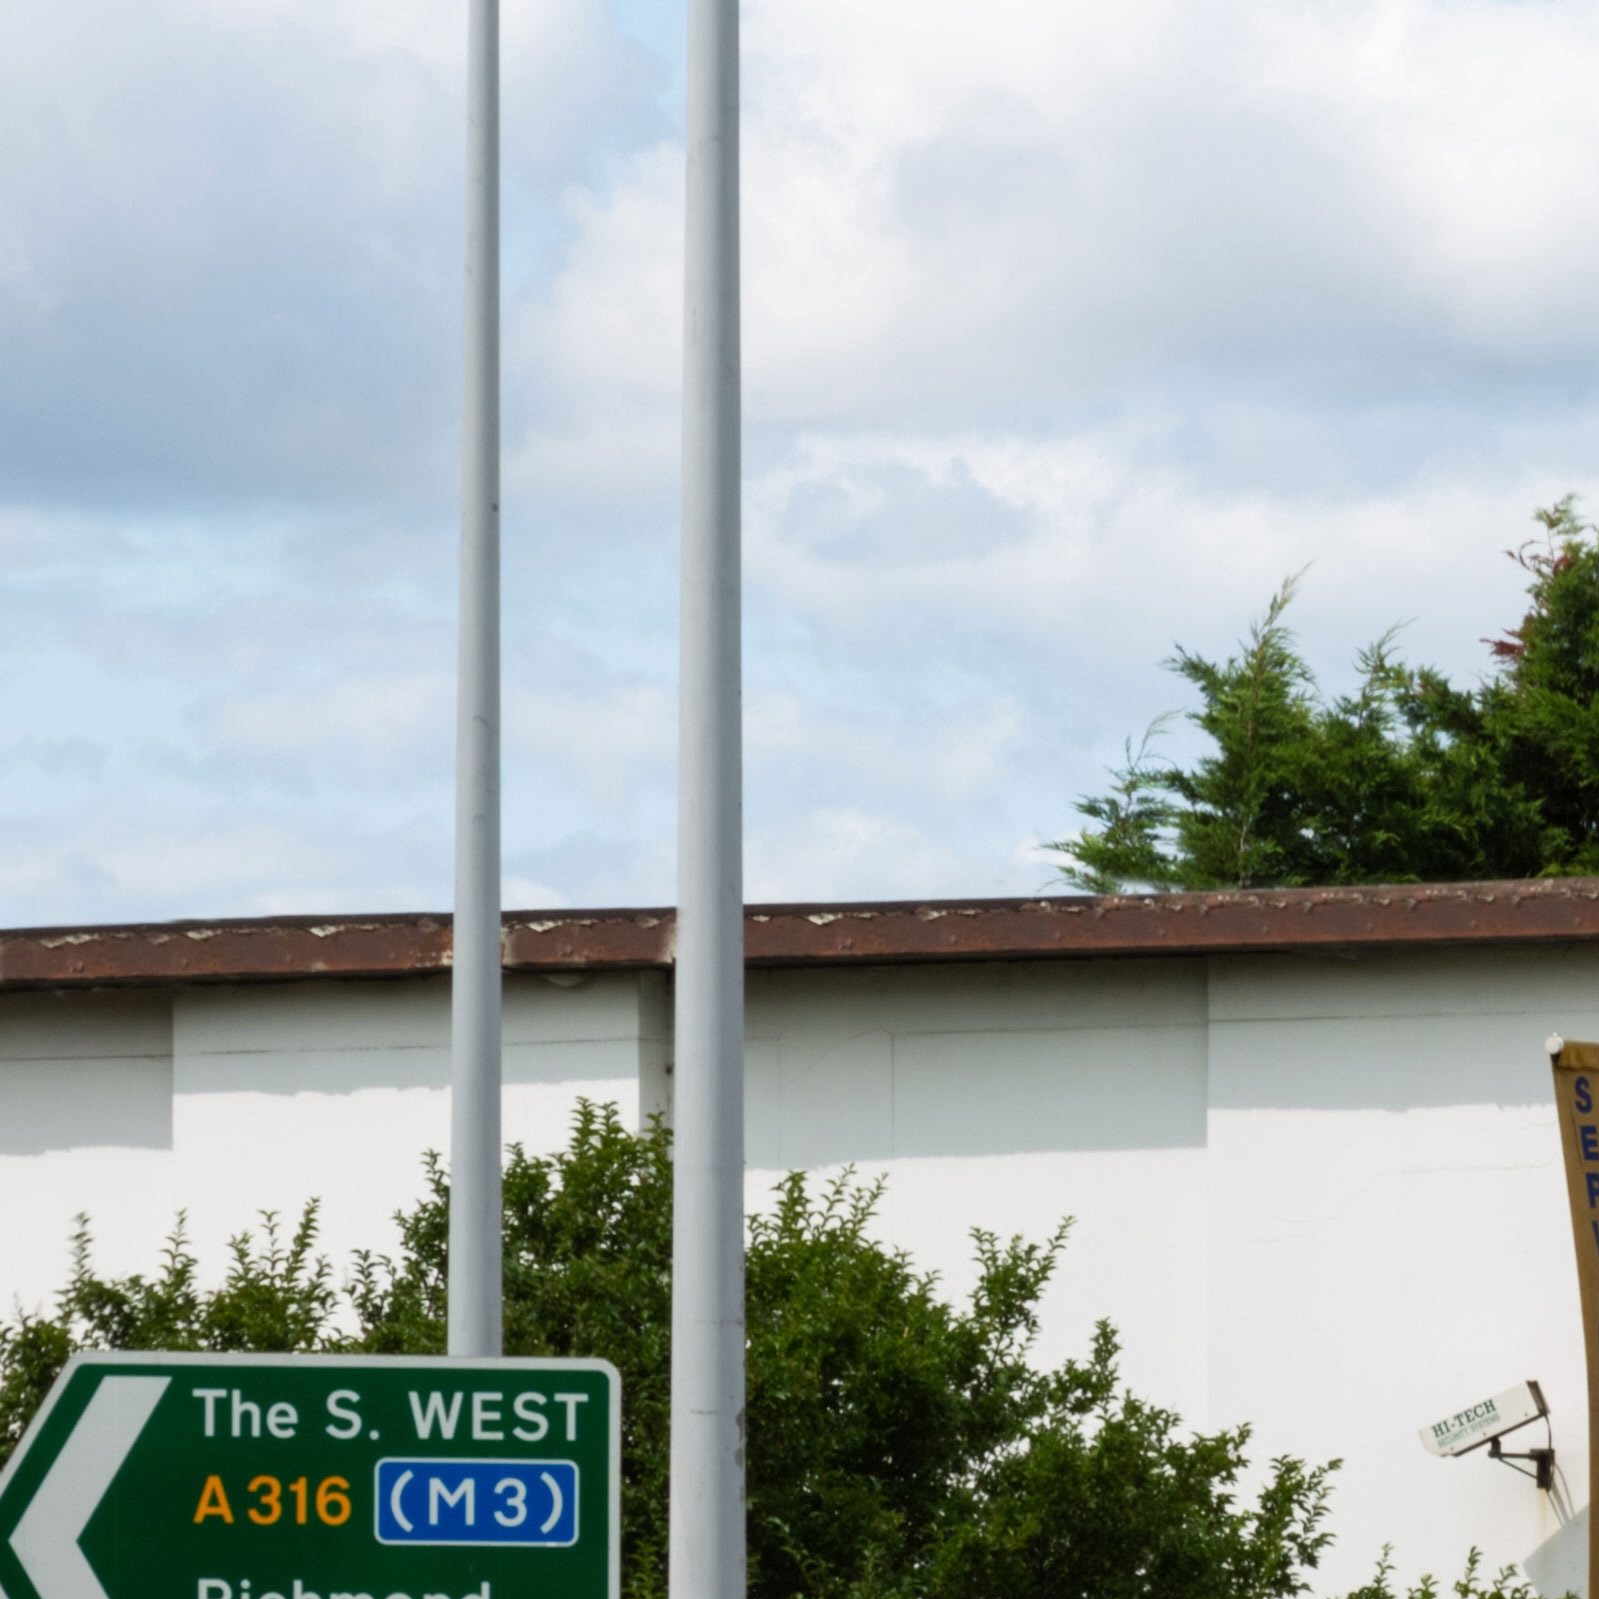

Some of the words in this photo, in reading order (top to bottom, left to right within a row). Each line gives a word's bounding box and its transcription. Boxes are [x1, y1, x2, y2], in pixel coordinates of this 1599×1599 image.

[193, 1389, 299, 1439] The
[326, 1390, 381, 1440] S.
[409, 1392, 590, 1442] WEST
[1432, 1399, 1497, 1438] HI-TECH
[194, 1476, 352, 1525] A316
[389, 1470, 564, 1534] (M3)
